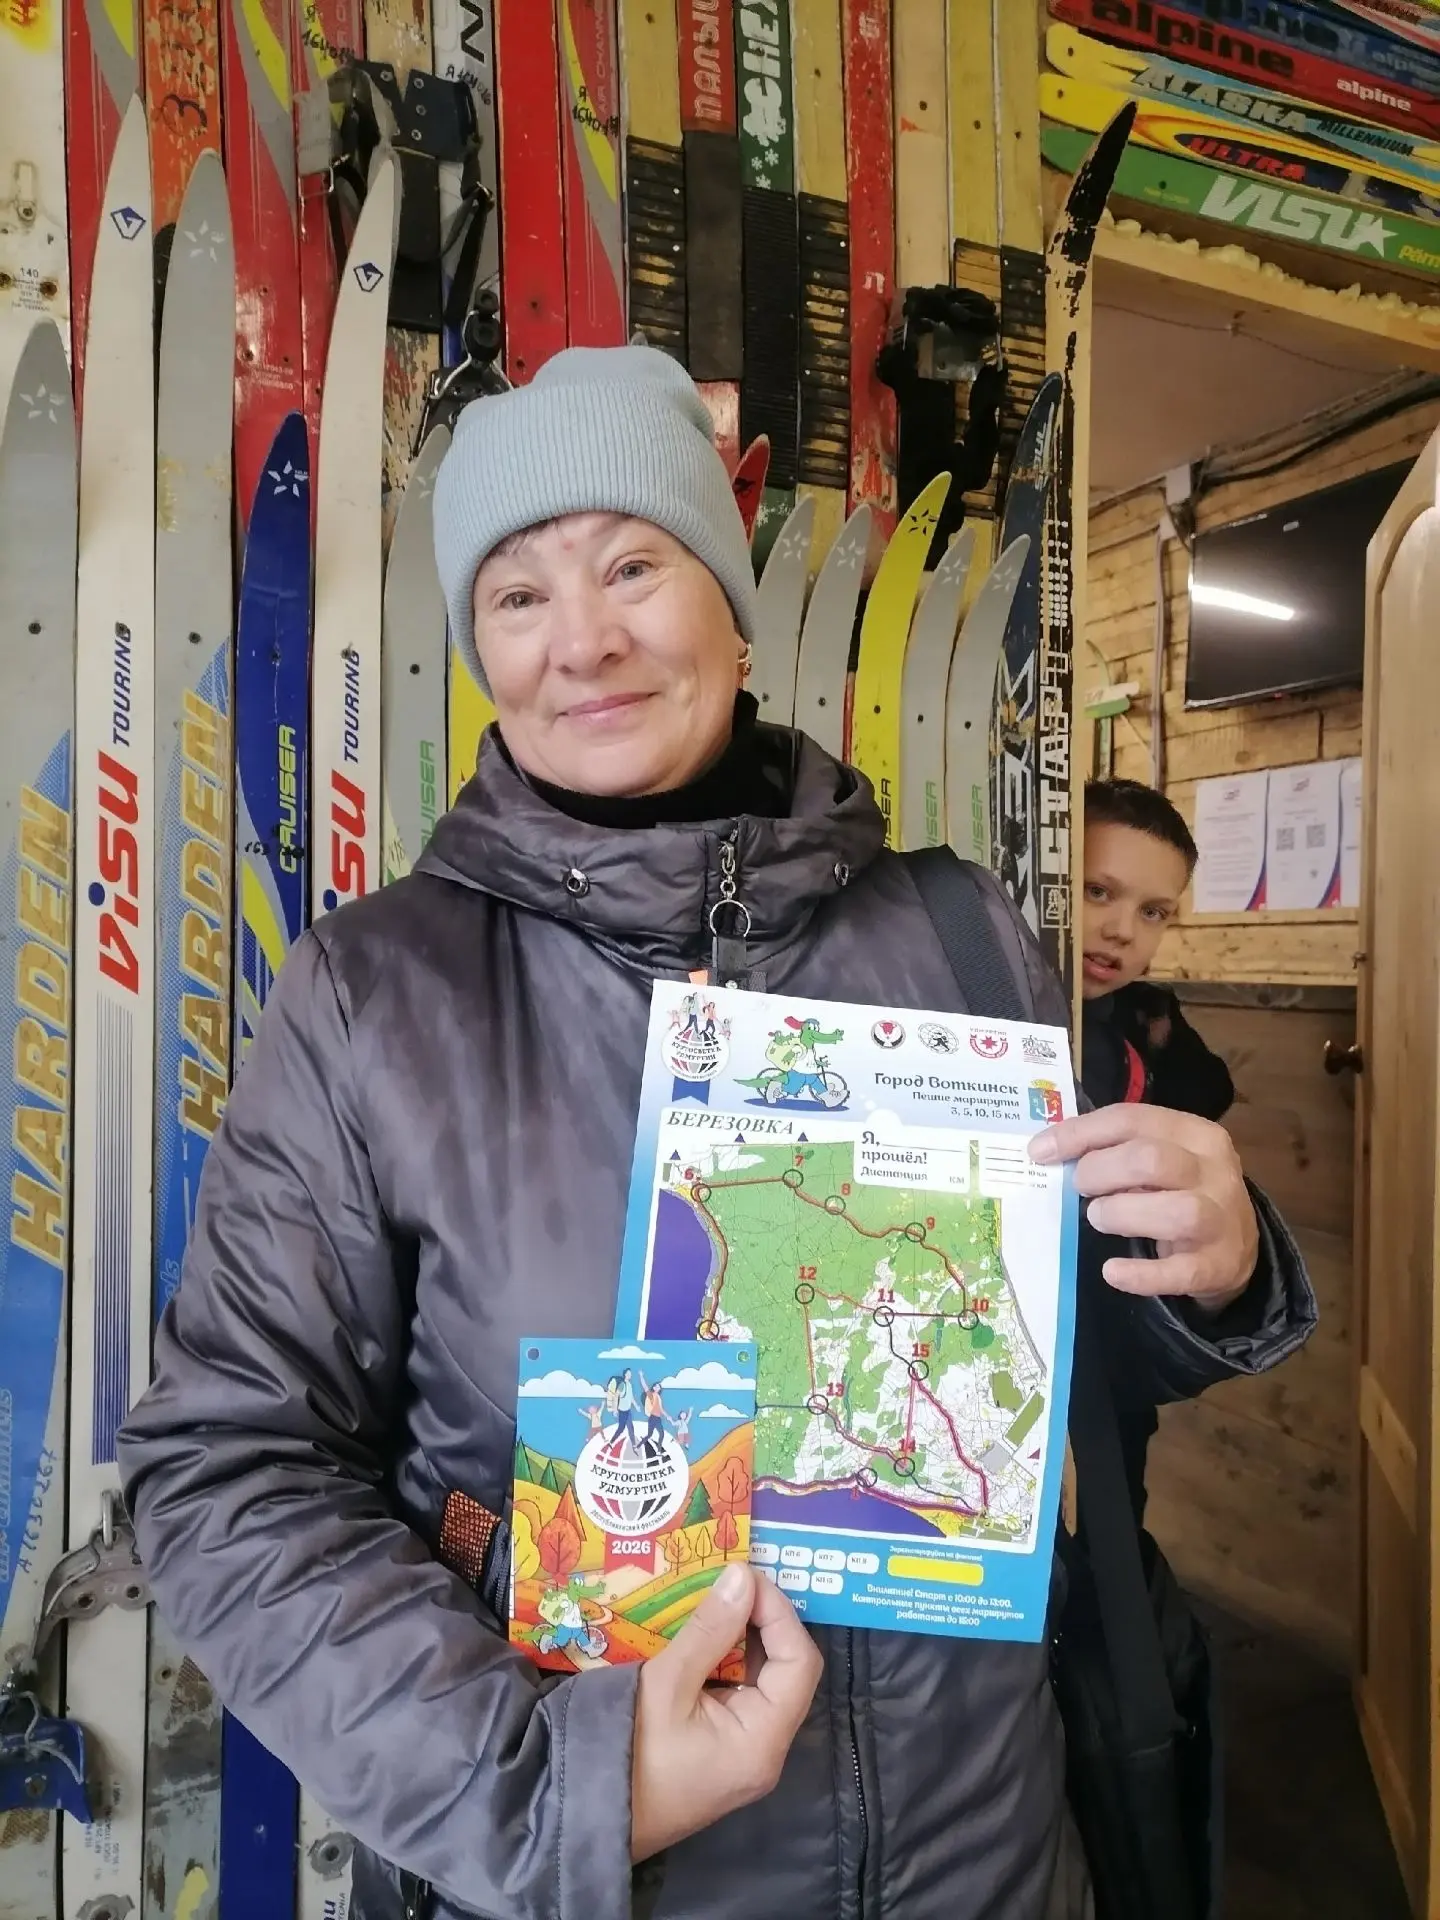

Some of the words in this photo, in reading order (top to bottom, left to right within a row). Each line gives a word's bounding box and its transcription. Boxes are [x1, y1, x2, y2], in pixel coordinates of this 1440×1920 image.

[1090, 0, 1294, 79] alpine
[1335, 77, 1413, 112] alpine
[1131, 66, 1308, 132] ALASKA
[1316, 118, 1415, 157] MILLENNIUM
[1186, 136, 1307, 181] ULTRA
[1199, 174, 1377, 252] VISU
[112, 625, 132, 747] TOURING
[344, 649, 361, 764] TOURING
[1039, 637, 1070, 876] СТАРТ
[278, 723, 297, 874] CRUISER
[178, 688, 230, 1139] HARDEN
[9, 782, 72, 1269] HARDEN
[875, 1072, 924, 1091] Город
[928, 1076, 1019, 1095] Воткинск
[912, 1091, 950, 1102] Пешие
[953, 1096, 1020, 1109] маршруты
[951, 1106, 961, 1116] 3,
[963, 1107, 973, 1118] 5,
[975, 1107, 990, 1118] 10,
[992, 1109, 1002, 1119] 15
[667, 1111, 795, 1137] БЕРЕЗОВКА
[861, 1130, 881, 1146] Я,
[794, 1155, 804, 1167] 7
[861, 1150, 928, 1165] прошёл!
[684, 1167, 694, 1181] 6
[860, 1165, 928, 1183] Дистанция
[840, 1183, 852, 1197] 8
[925, 1216, 936, 1231] 9
[798, 1265, 817, 1281] 12
[876, 1289, 896, 1304] 11
[971, 1297, 990, 1313] 10
[911, 1343, 931, 1358] 15
[826, 1383, 845, 1397] 13
[590, 1463, 676, 1485] КРУГОСВЕТКА
[598, 1480, 668, 1496] УДМУРТИИ
[611, 1540, 652, 1556] 2026
[867, 1583, 914, 1598] Внимание!
[914, 1589, 946, 1602] Старт
[954, 1594, 976, 1604] 10:00
[977, 1596, 988, 1605] до
[852, 1593, 913, 1608] Контрольные
[914, 1601, 950, 1613] пункты
[971, 1609, 1025, 1620] маршрутов
[896, 1609, 946, 1623] работают
[946, 1614, 957, 1624] до
